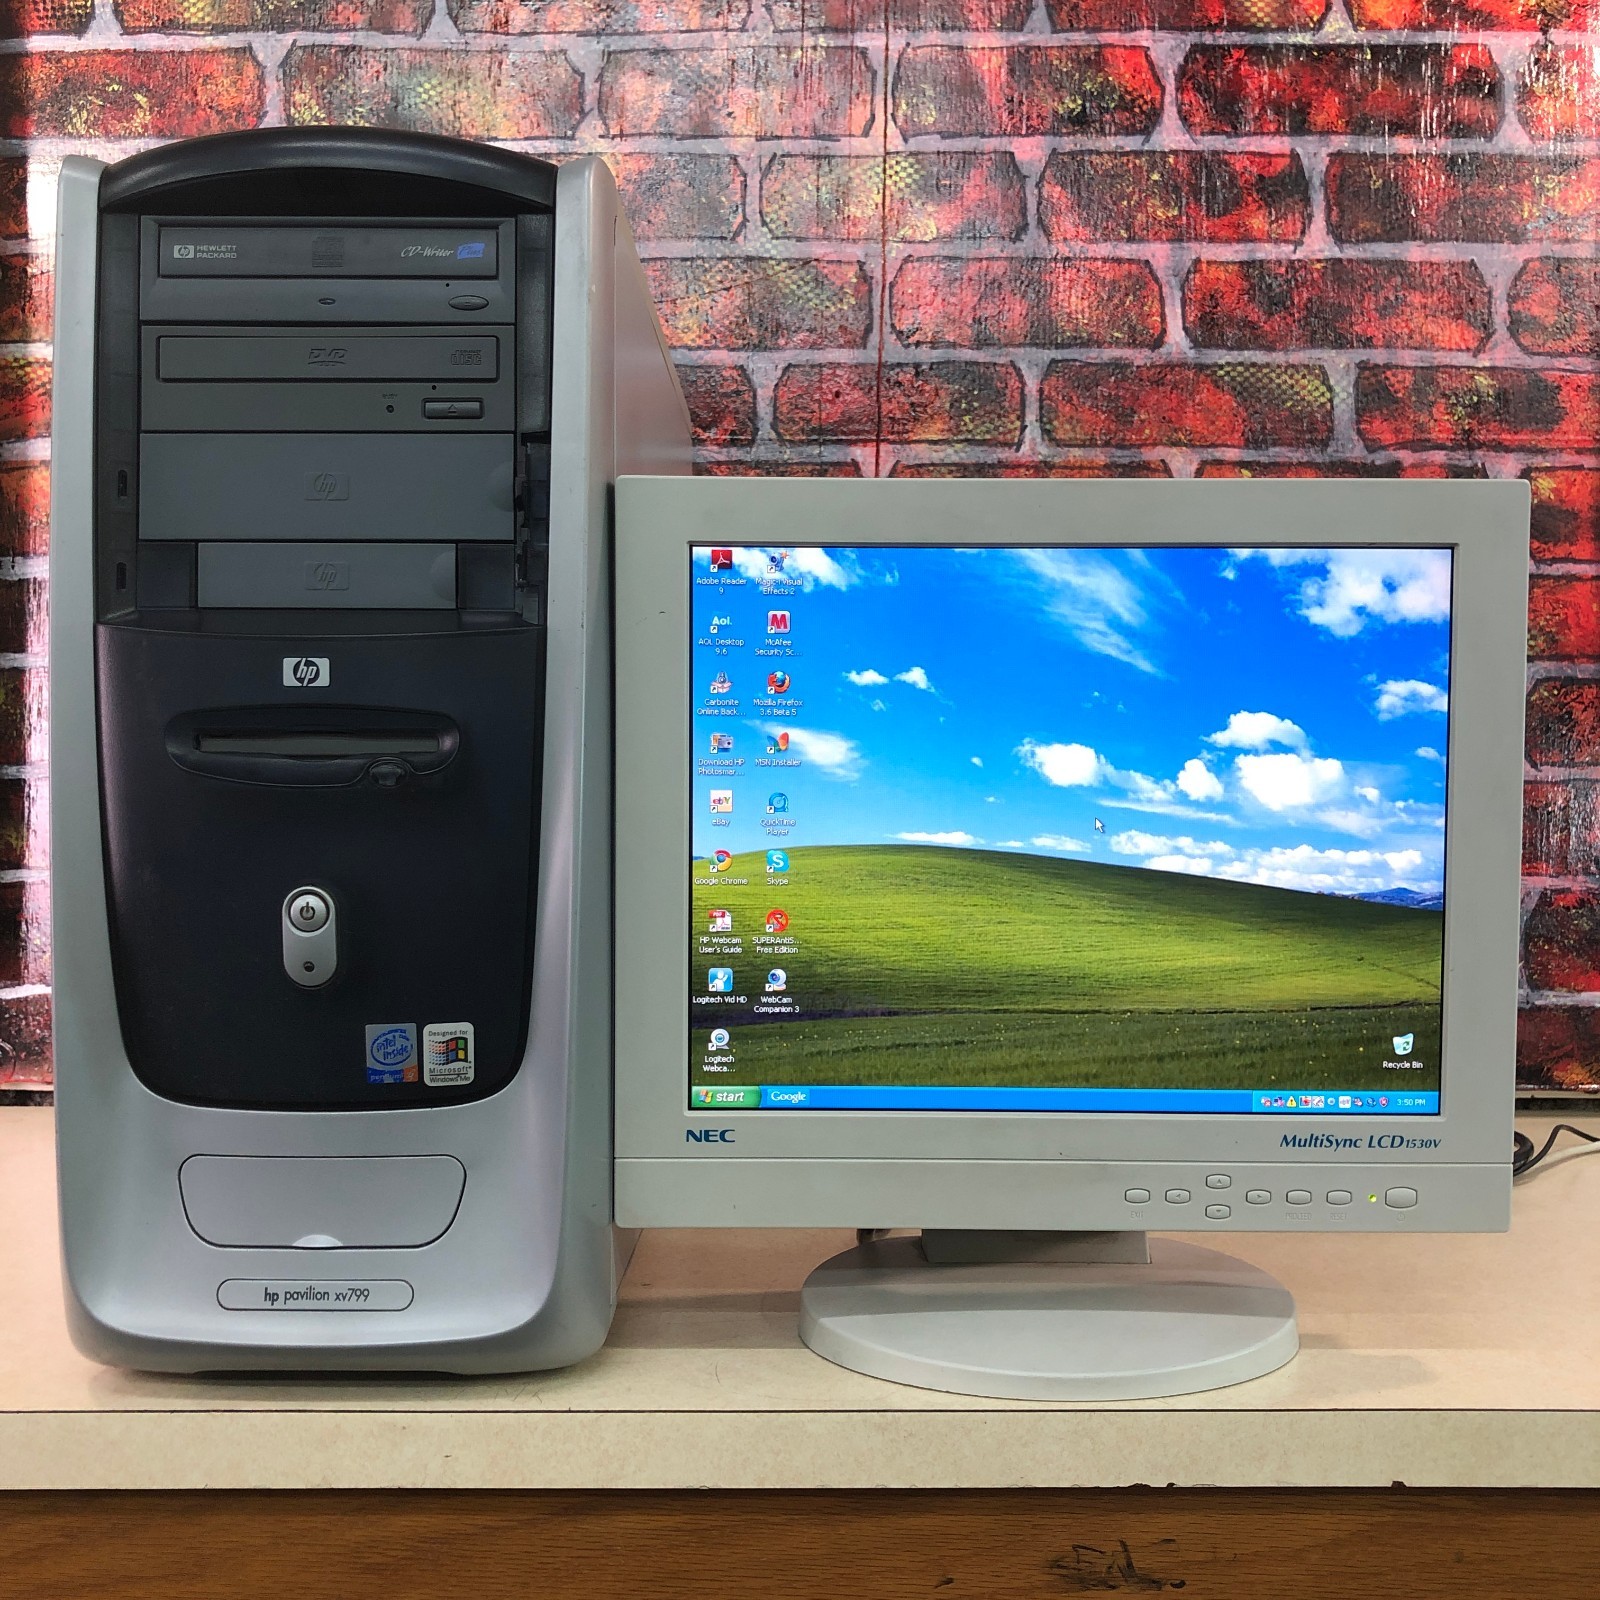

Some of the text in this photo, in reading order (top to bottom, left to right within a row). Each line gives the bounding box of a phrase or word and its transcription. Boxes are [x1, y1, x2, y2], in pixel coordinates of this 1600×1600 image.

[401, 246, 454, 257] CD-Writer
[309, 348, 347, 359] DVD
[696, 577, 747, 585] Adobe Reader
[718, 587, 724, 595] 9
[763, 587, 795, 595] Effects 2
[699, 638, 745, 648] AOL Desktop
[765, 639, 792, 647] McAfee
[715, 648, 728, 656] 9.6
[755, 648, 783, 657] Security
[295, 658, 318, 686] hp
[704, 699, 739, 707] Carbonite
[753, 699, 803, 707] Mozilla Firefox
[697, 708, 719, 716] Online
[774, 709, 790, 717] Beta
[792, 709, 797, 717] 5
[699, 759, 745, 767] Download HP
[755, 759, 801, 767] MSN Installer
[712, 819, 730, 827] eBay
[760, 819, 796, 828] QuickTime
[766, 828, 789, 837] Player
[694, 877, 748, 887] Google Chrome
[766, 877, 789, 887] Skype
[692, 996, 722, 1005] Logitech
[760, 996, 793, 1004] WebCam
[753, 1006, 793, 1015] Companion
[704, 1055, 735, 1064] Logitech
[1382, 1061, 1423, 1070] Recycle Bin
[716, 1091, 745, 1102] start
[771, 1091, 807, 1104] Google
[1397, 1098, 1427, 1107] 3:50 PM
[686, 1129, 736, 1143] NEC
[1280, 1133, 1363, 1152] MultiSync
[1130, 1211, 1144, 1219] EXIT
[1330, 1212, 1347, 1220] RESET
[264, 1285, 370, 1306] hp pavilion xv799
